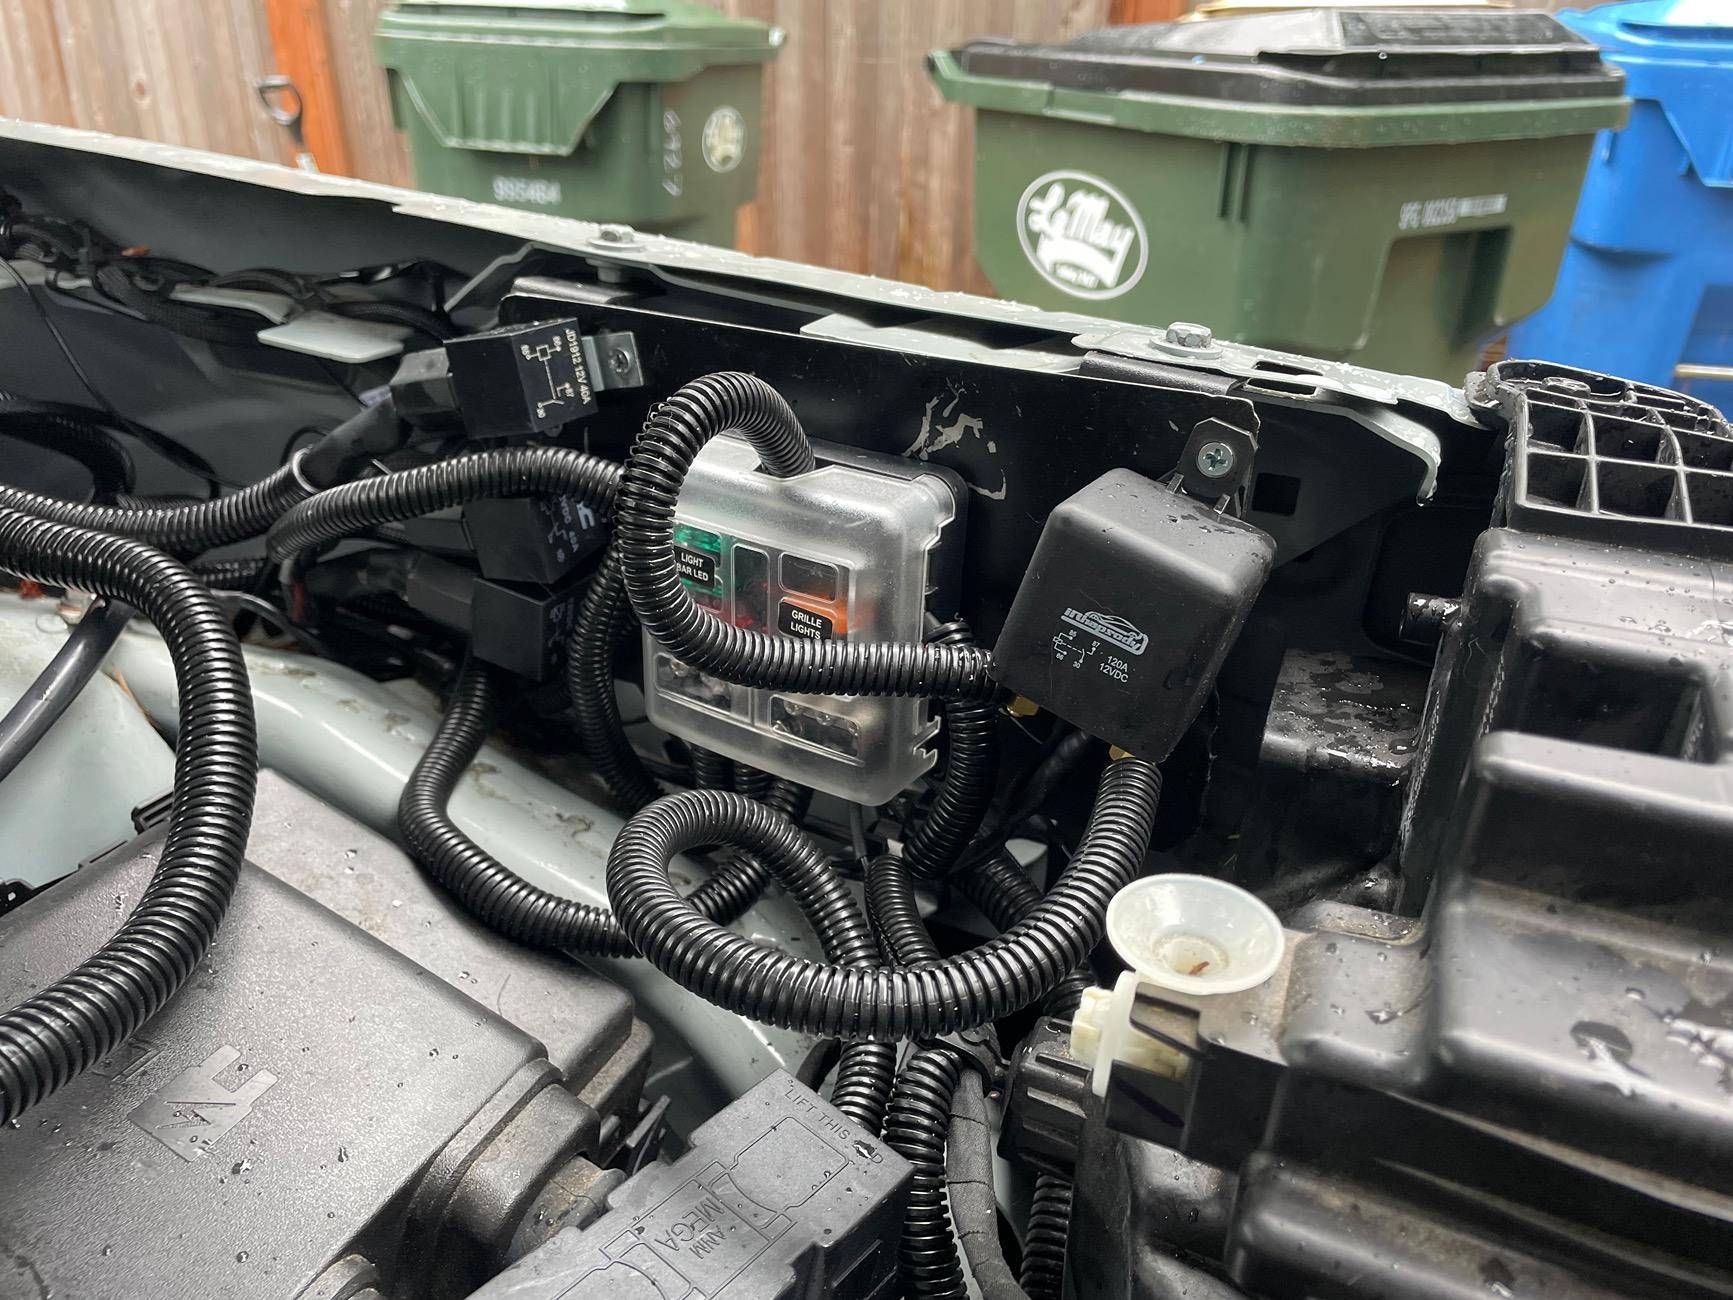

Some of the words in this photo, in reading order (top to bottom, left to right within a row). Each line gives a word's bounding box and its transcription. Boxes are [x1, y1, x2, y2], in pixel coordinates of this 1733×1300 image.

[564, 328, 582, 365] JD1912
[575, 365, 587, 384] 12V
[580, 384, 592, 405] 40A
[681, 551, 704, 568] LIGHT
[676, 563, 694, 578] BAR
[693, 568, 709, 582] LED
[791, 609, 822, 629] GRILLE
[790, 622, 821, 640] LIGHTS
[1099, 662, 1129, 683] 12VDC
[1107, 655, 1129, 673] 120A
[784, 1088, 818, 1114] LIFT
[814, 1111, 851, 1140] THIS
[654, 1196, 726, 1253] MEGA
